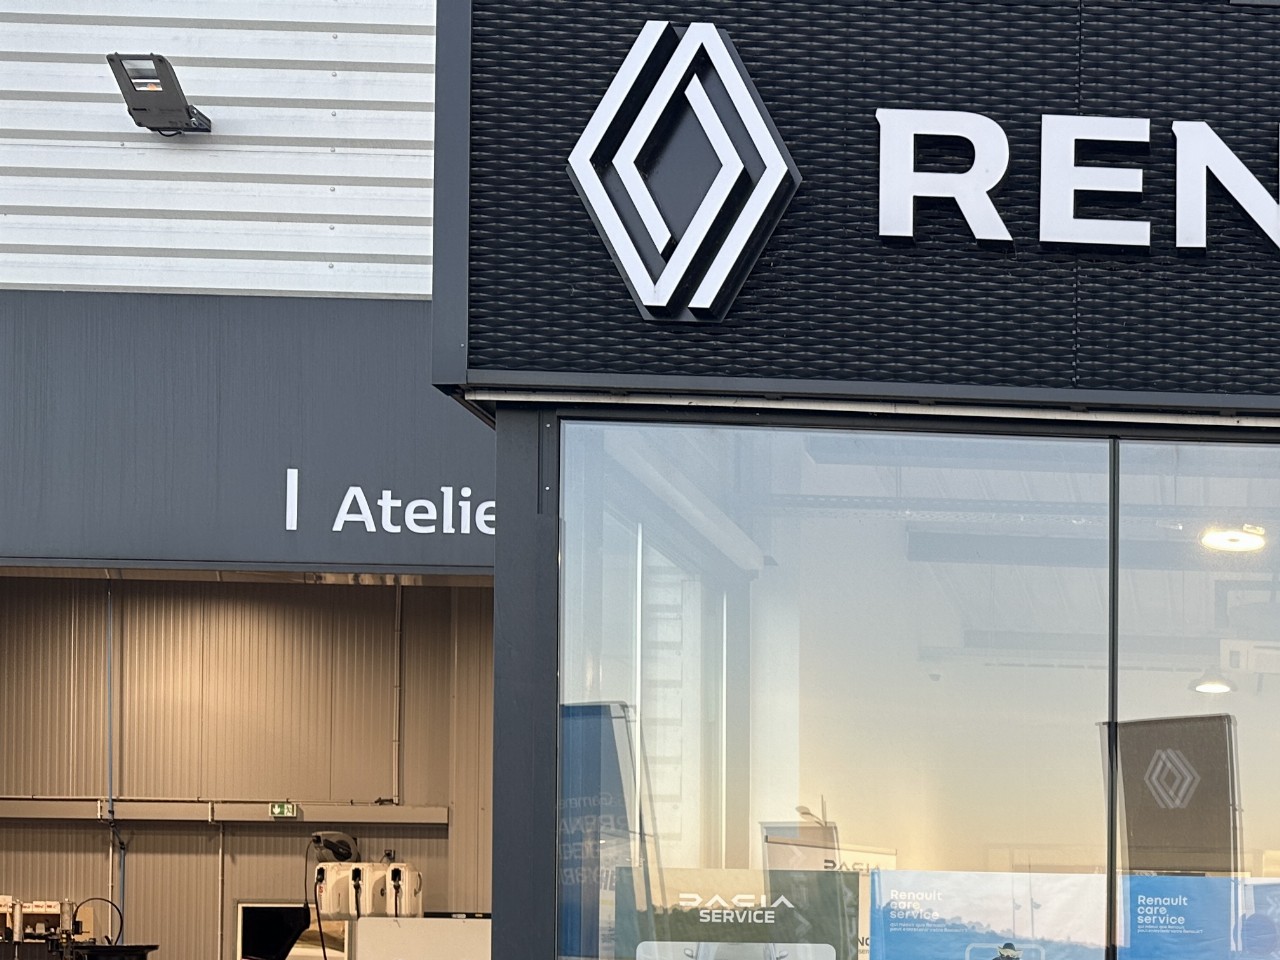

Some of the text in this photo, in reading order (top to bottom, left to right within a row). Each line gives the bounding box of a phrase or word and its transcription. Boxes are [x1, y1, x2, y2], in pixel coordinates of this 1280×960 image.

[332, 486, 496, 534] Atelie
[679, 893, 795, 908] DACIA
[890, 889, 943, 901] Renault
[1137, 895, 1188, 906] Renault
[889, 900, 920, 910] care
[1137, 906, 1167, 915] care
[699, 909, 775, 924] SERVICE
[889, 908, 940, 920] service
[1137, 914, 1185, 925] service
